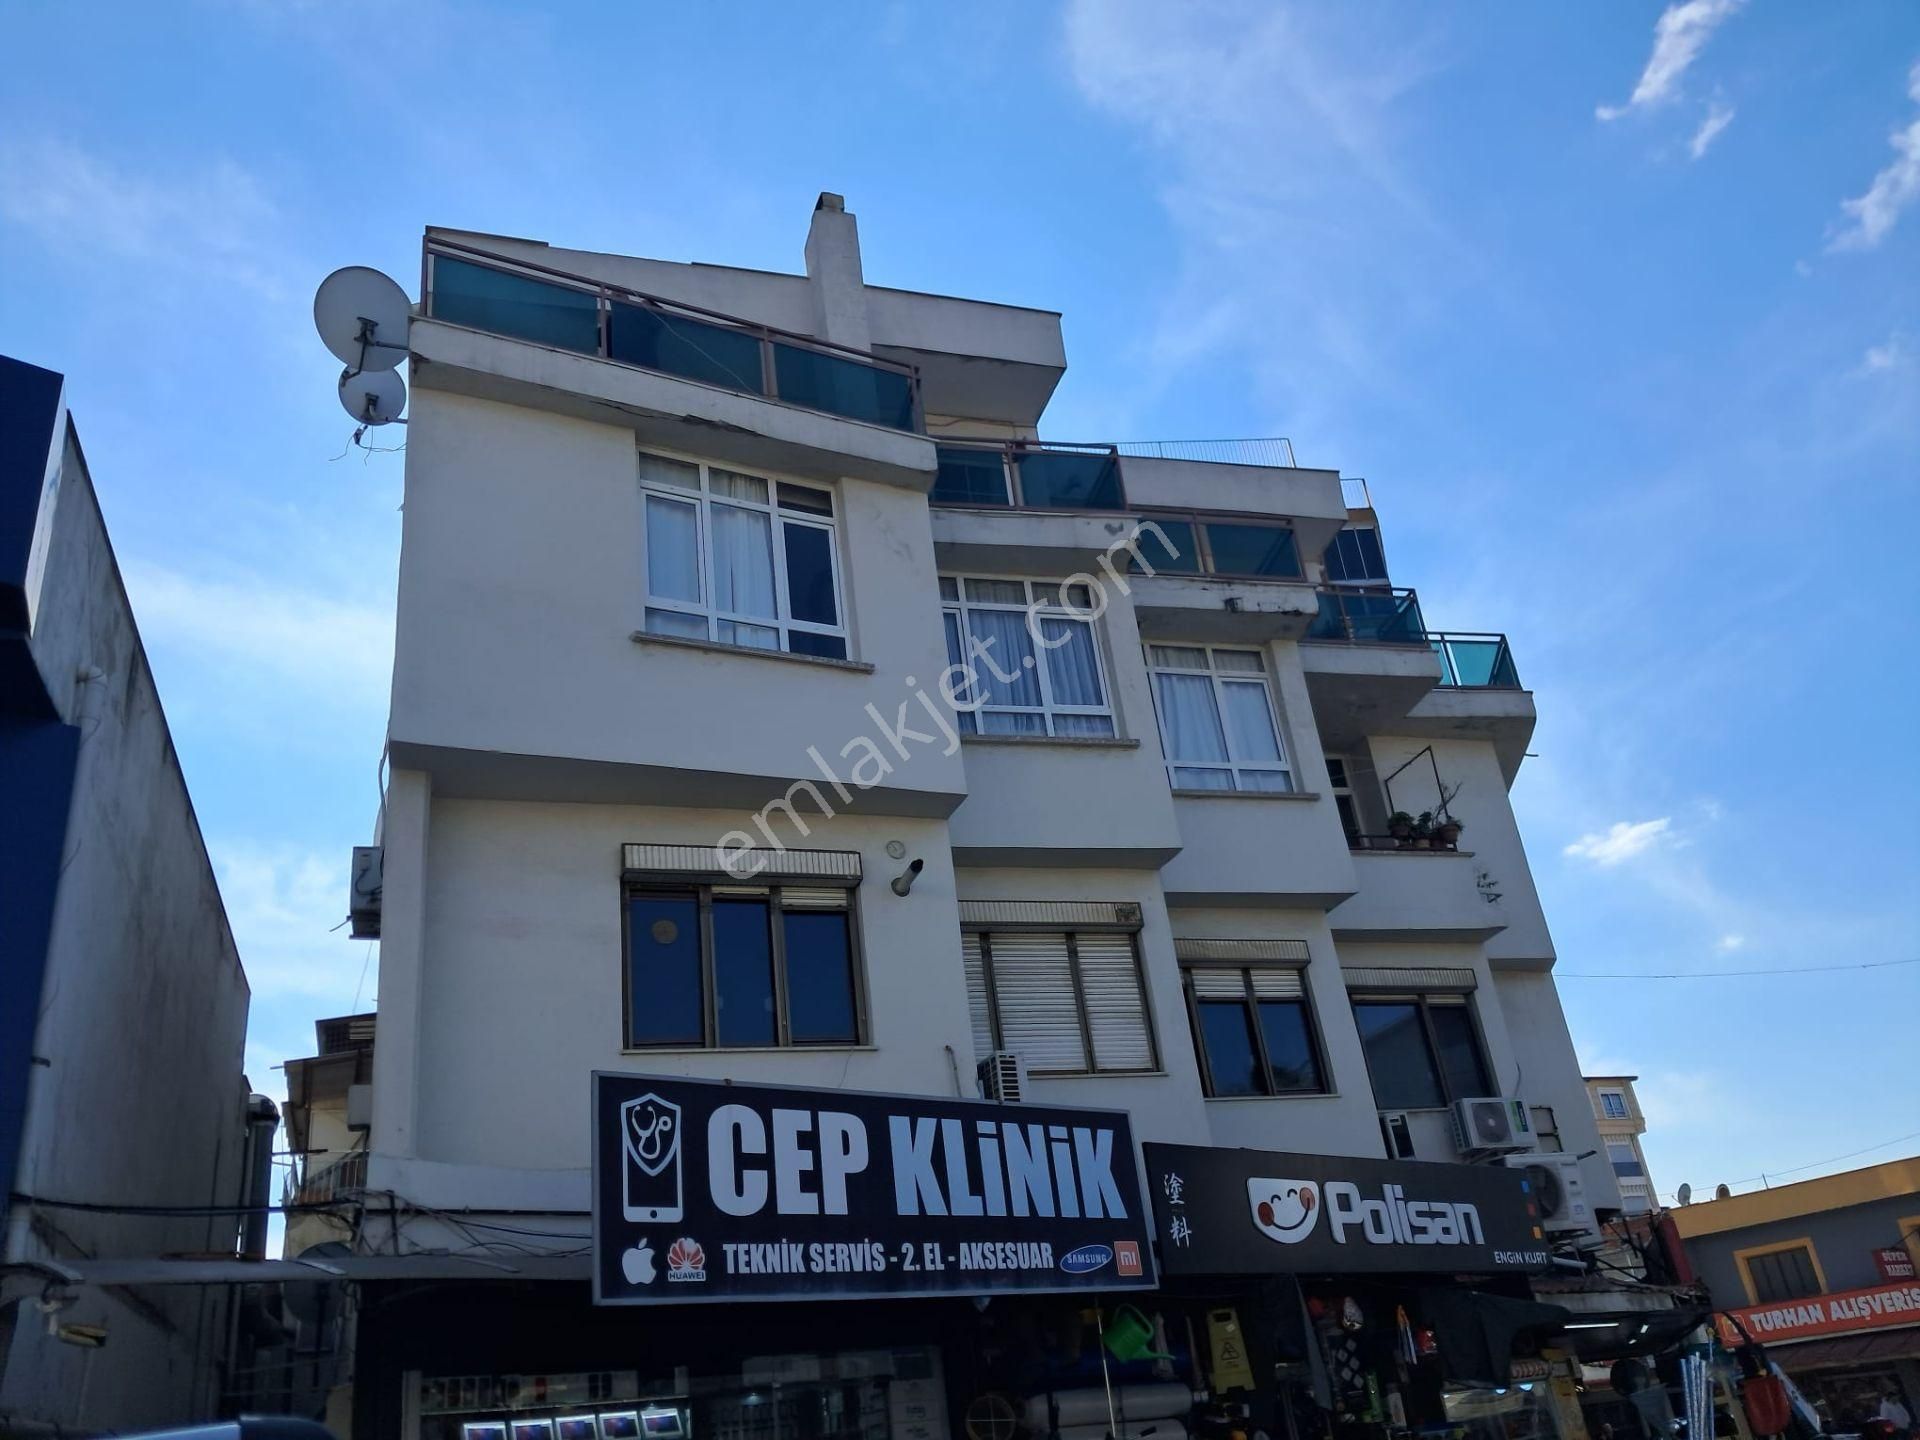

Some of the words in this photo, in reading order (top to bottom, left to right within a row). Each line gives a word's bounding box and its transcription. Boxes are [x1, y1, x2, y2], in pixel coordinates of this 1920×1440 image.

[707, 1103, 869, 1217] CEP
[1322, 1180, 1485, 1245] Polisan
[722, 1238, 807, 1274] TEKNİK
[810, 1238, 885, 1273] SERVİS
[901, 1242, 921, 1272] 2.
[923, 1242, 945, 1271] EL
[959, 1240, 1054, 1271] AKSESUAR
[1067, 1253, 1107, 1265] SAMSUNG
[1523, 1251, 1548, 1265] KURT
[669, 1270, 705, 1282] HUAWEI
[1750, 1303, 1826, 1333] TURHAN
